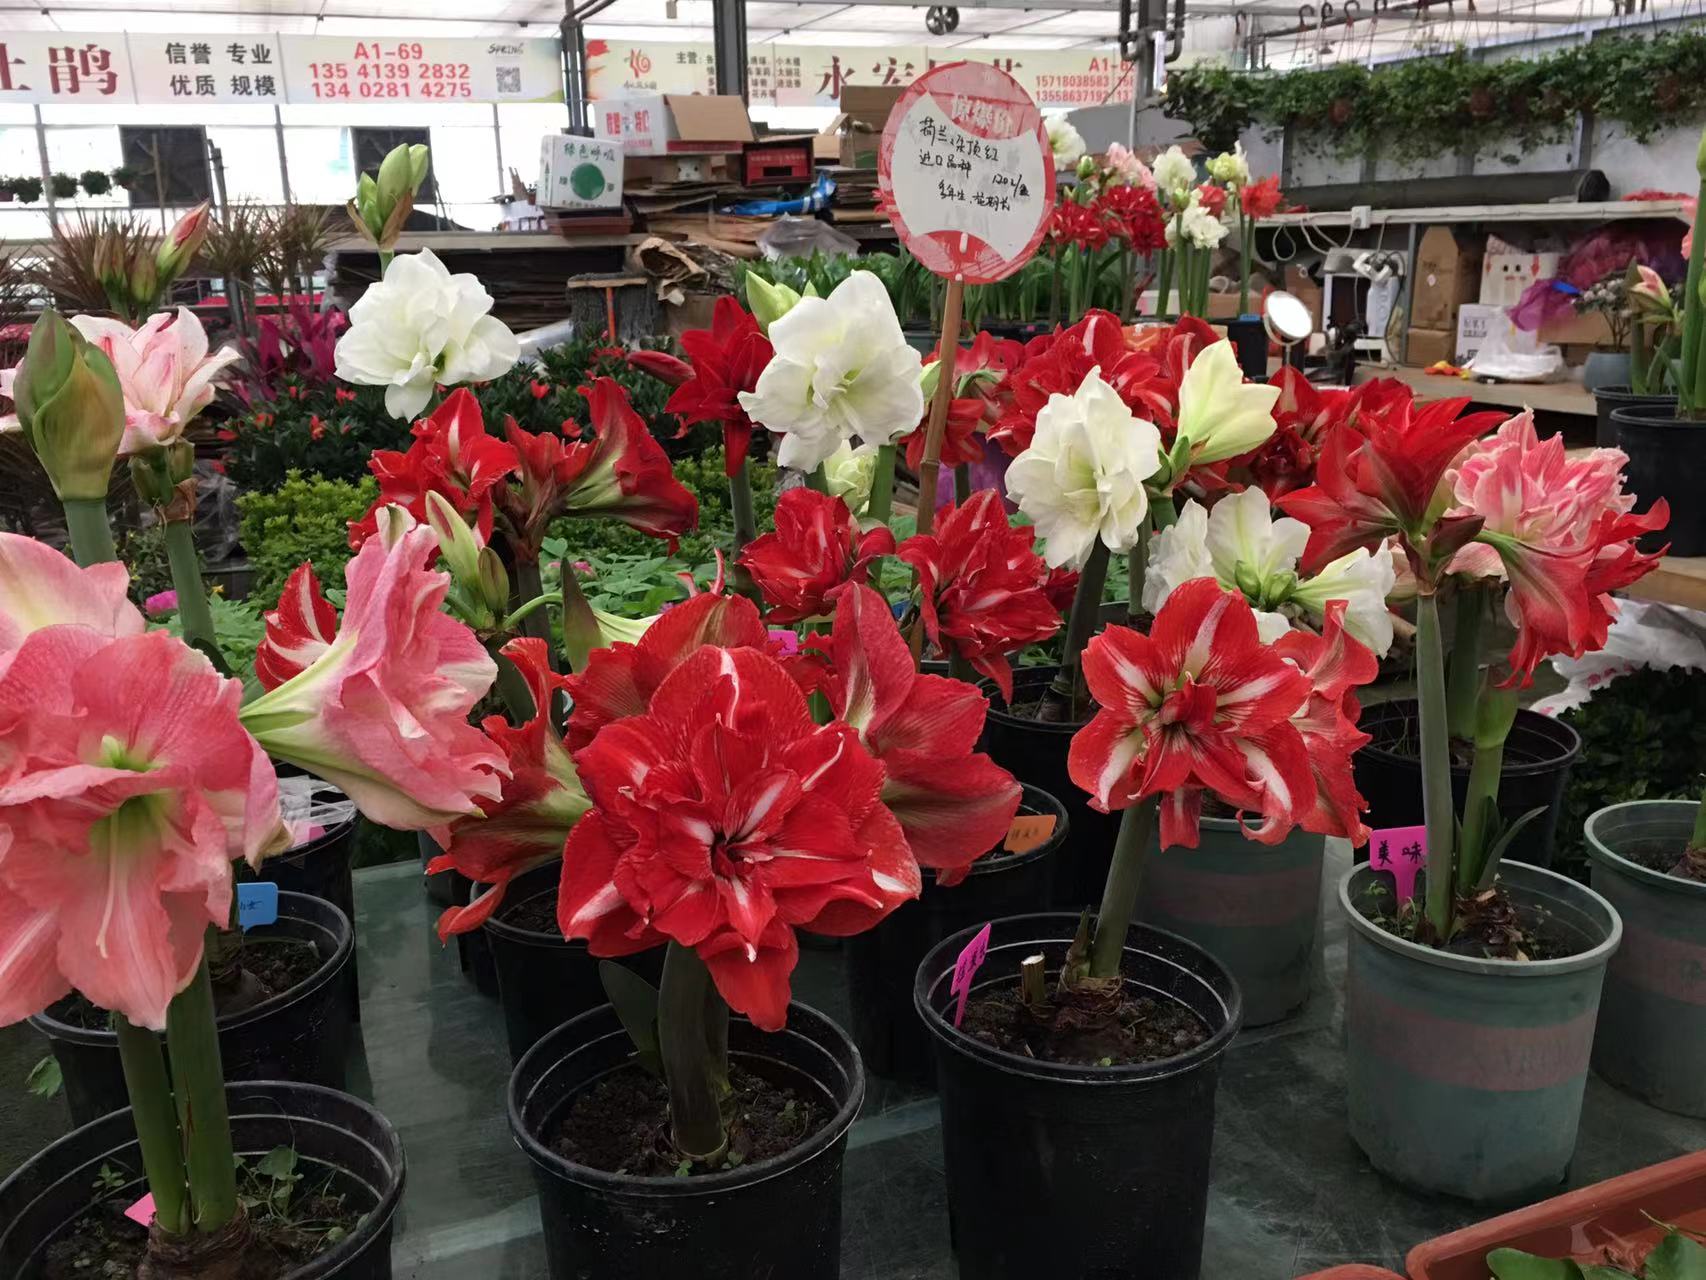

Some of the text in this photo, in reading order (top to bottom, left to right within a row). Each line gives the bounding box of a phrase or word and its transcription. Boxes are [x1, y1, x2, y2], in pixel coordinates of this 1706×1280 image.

[165, 42, 272, 64] 信誉 专业
[354, 42, 423, 60] A1-69
[309, 63, 470, 79] 135 4139 2832
[1089, 57, 1135, 72] A1-6
[170, 74, 276, 96] 优质 规模
[312, 82, 472, 98] 134 0281 4275
